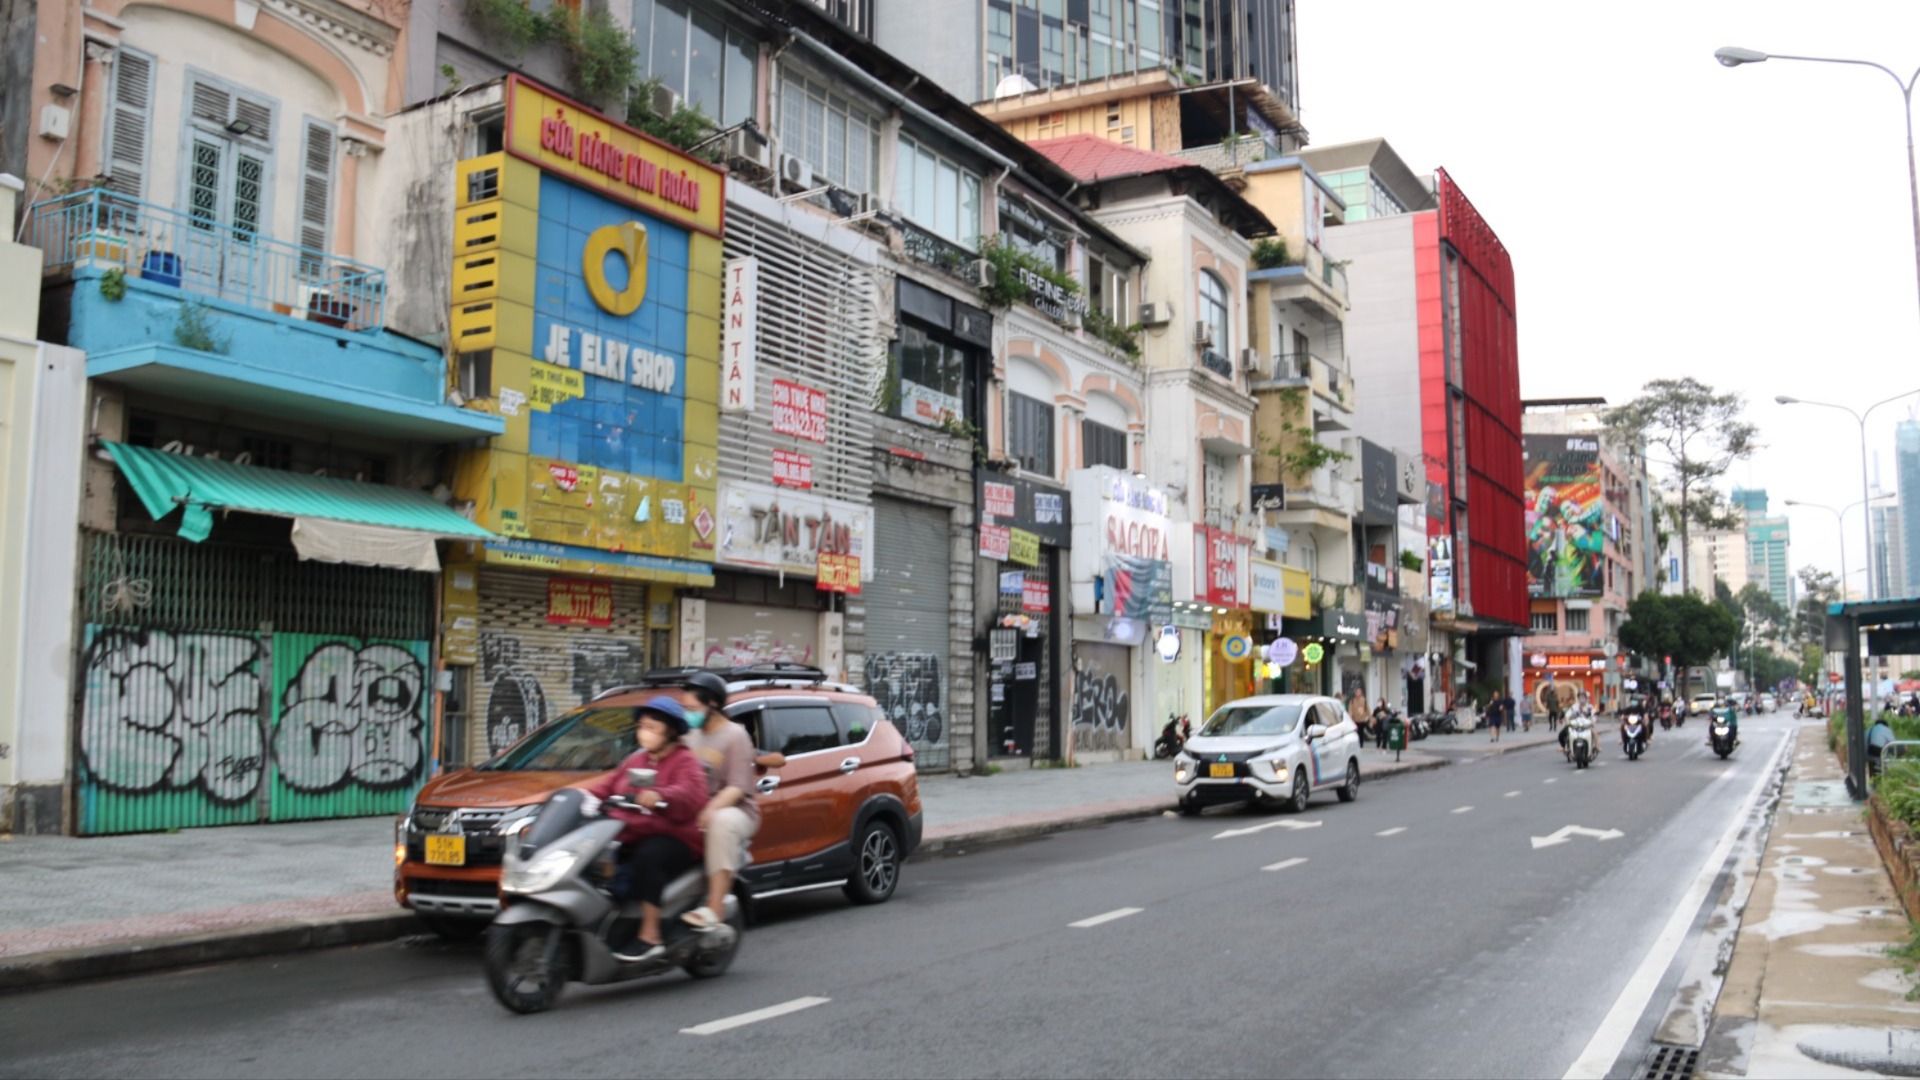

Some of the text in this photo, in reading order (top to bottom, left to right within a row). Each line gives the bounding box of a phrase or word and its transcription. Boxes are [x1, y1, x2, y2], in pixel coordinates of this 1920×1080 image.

[541, 108, 699, 212] CỬA HÀNG KIM HOÀN
[631, 347, 676, 394] SHOP
[729, 268, 743, 404] TÂN TÂN
[752, 502, 851, 555] TÂN TÂN
